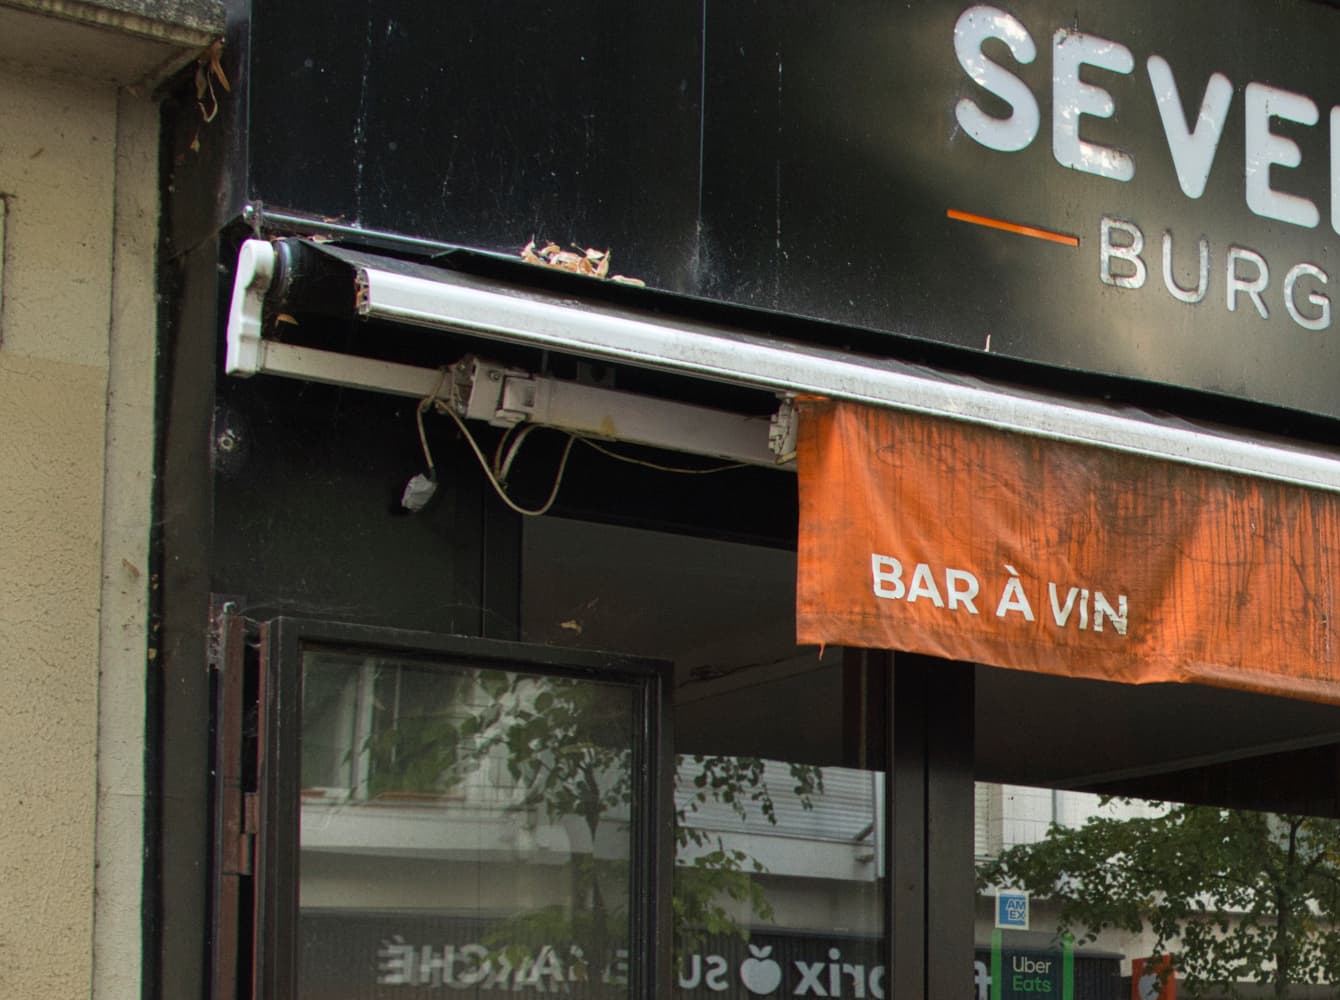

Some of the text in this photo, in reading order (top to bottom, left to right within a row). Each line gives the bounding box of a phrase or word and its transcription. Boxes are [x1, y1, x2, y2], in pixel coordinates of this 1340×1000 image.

[871, 552, 1128, 635] BAR À VIN
[1012, 955, 1052, 974] Uber
[1012, 974, 1052, 993] Eats
